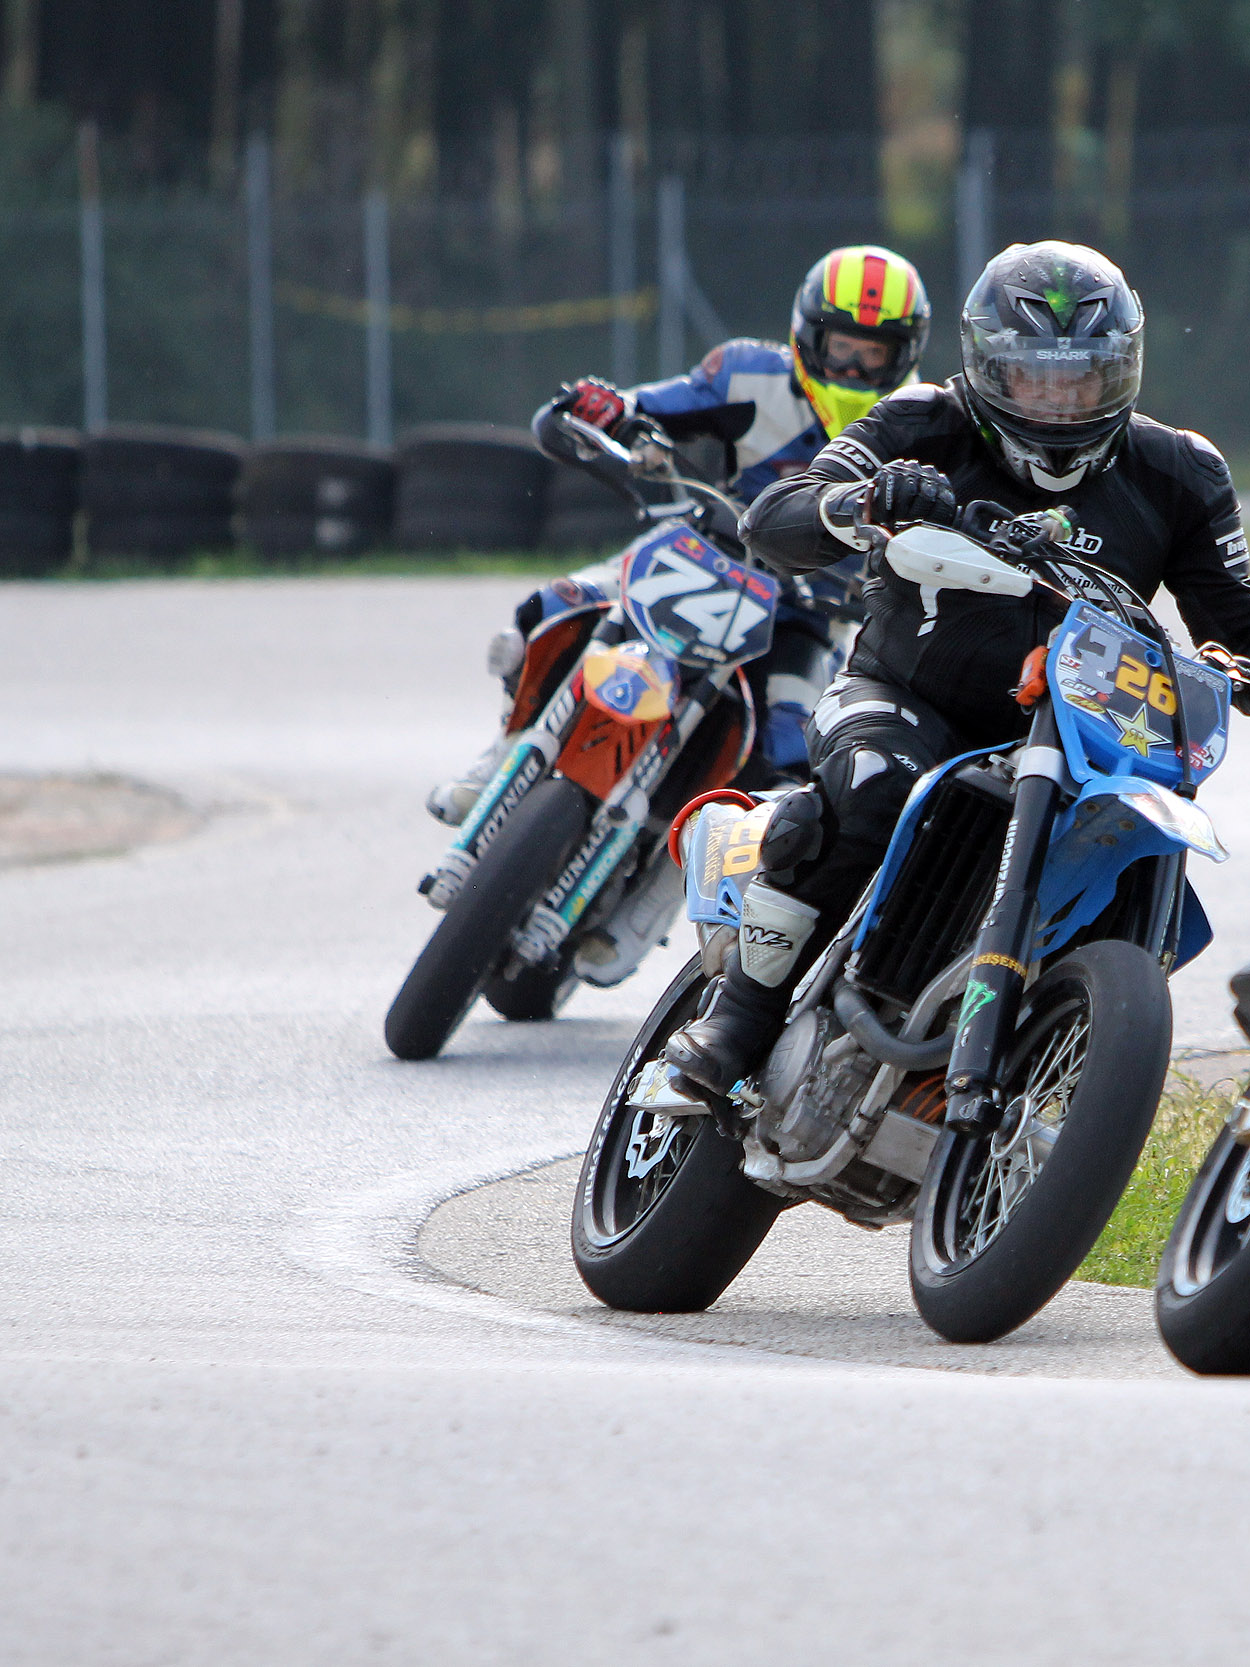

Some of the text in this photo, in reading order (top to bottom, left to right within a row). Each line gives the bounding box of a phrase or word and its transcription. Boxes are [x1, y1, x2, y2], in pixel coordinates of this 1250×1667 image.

[1036, 350, 1091, 361] SHARK
[624, 546, 770, 653] 74
[1115, 655, 1177, 716] 26
[474, 755, 541, 859] DUNLOP
